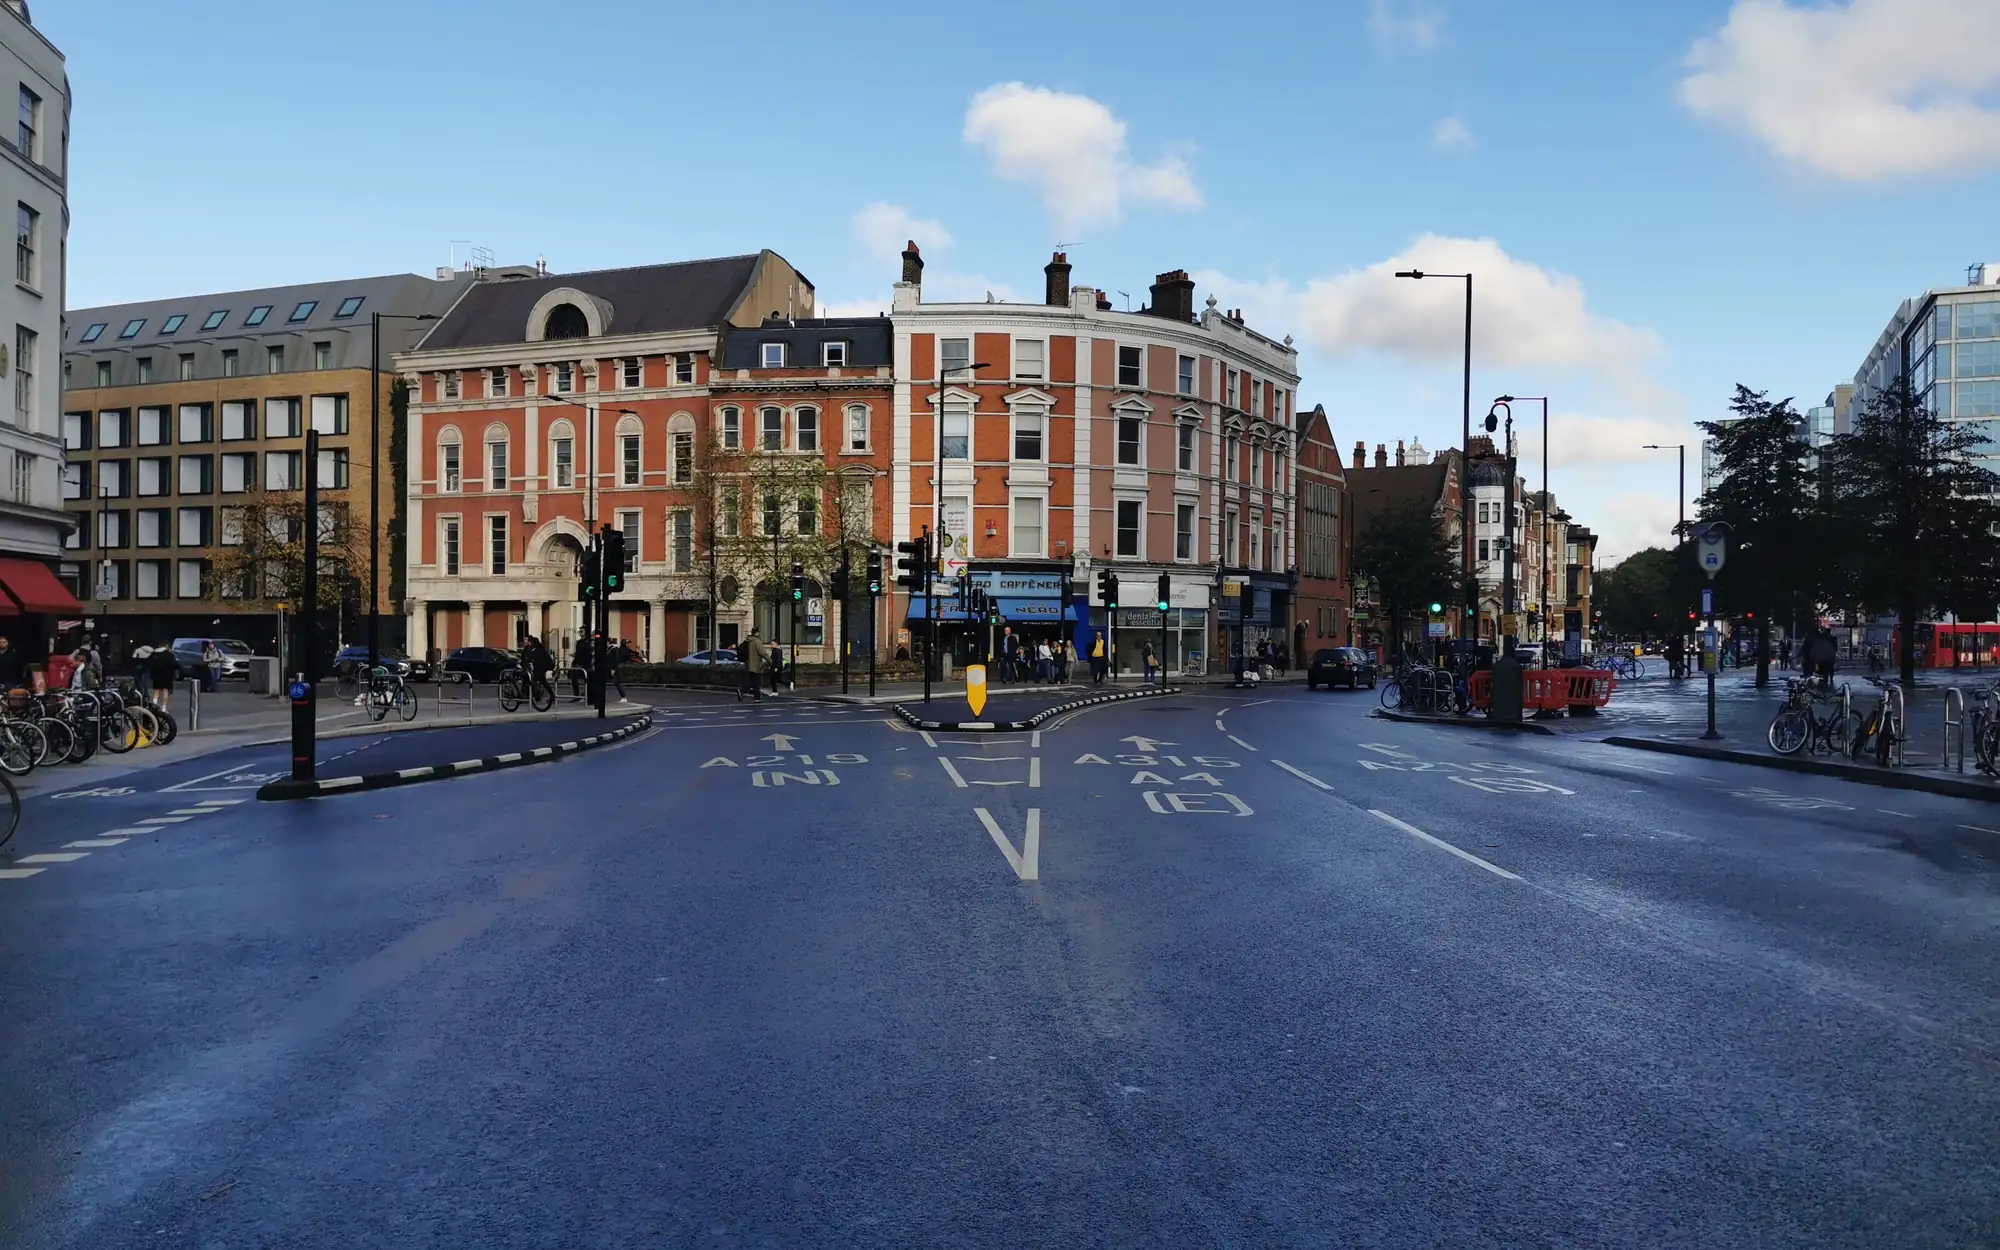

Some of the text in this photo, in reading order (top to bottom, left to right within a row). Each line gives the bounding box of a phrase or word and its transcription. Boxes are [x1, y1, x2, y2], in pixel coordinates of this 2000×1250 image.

[1127, 611, 1152, 621] dental
[698, 753, 869, 769] A219
[1073, 753, 1242, 768] A315
[751, 769, 841, 788] (N)
[1130, 770, 1225, 787] A4
[1142, 790, 1255, 817] (E)
